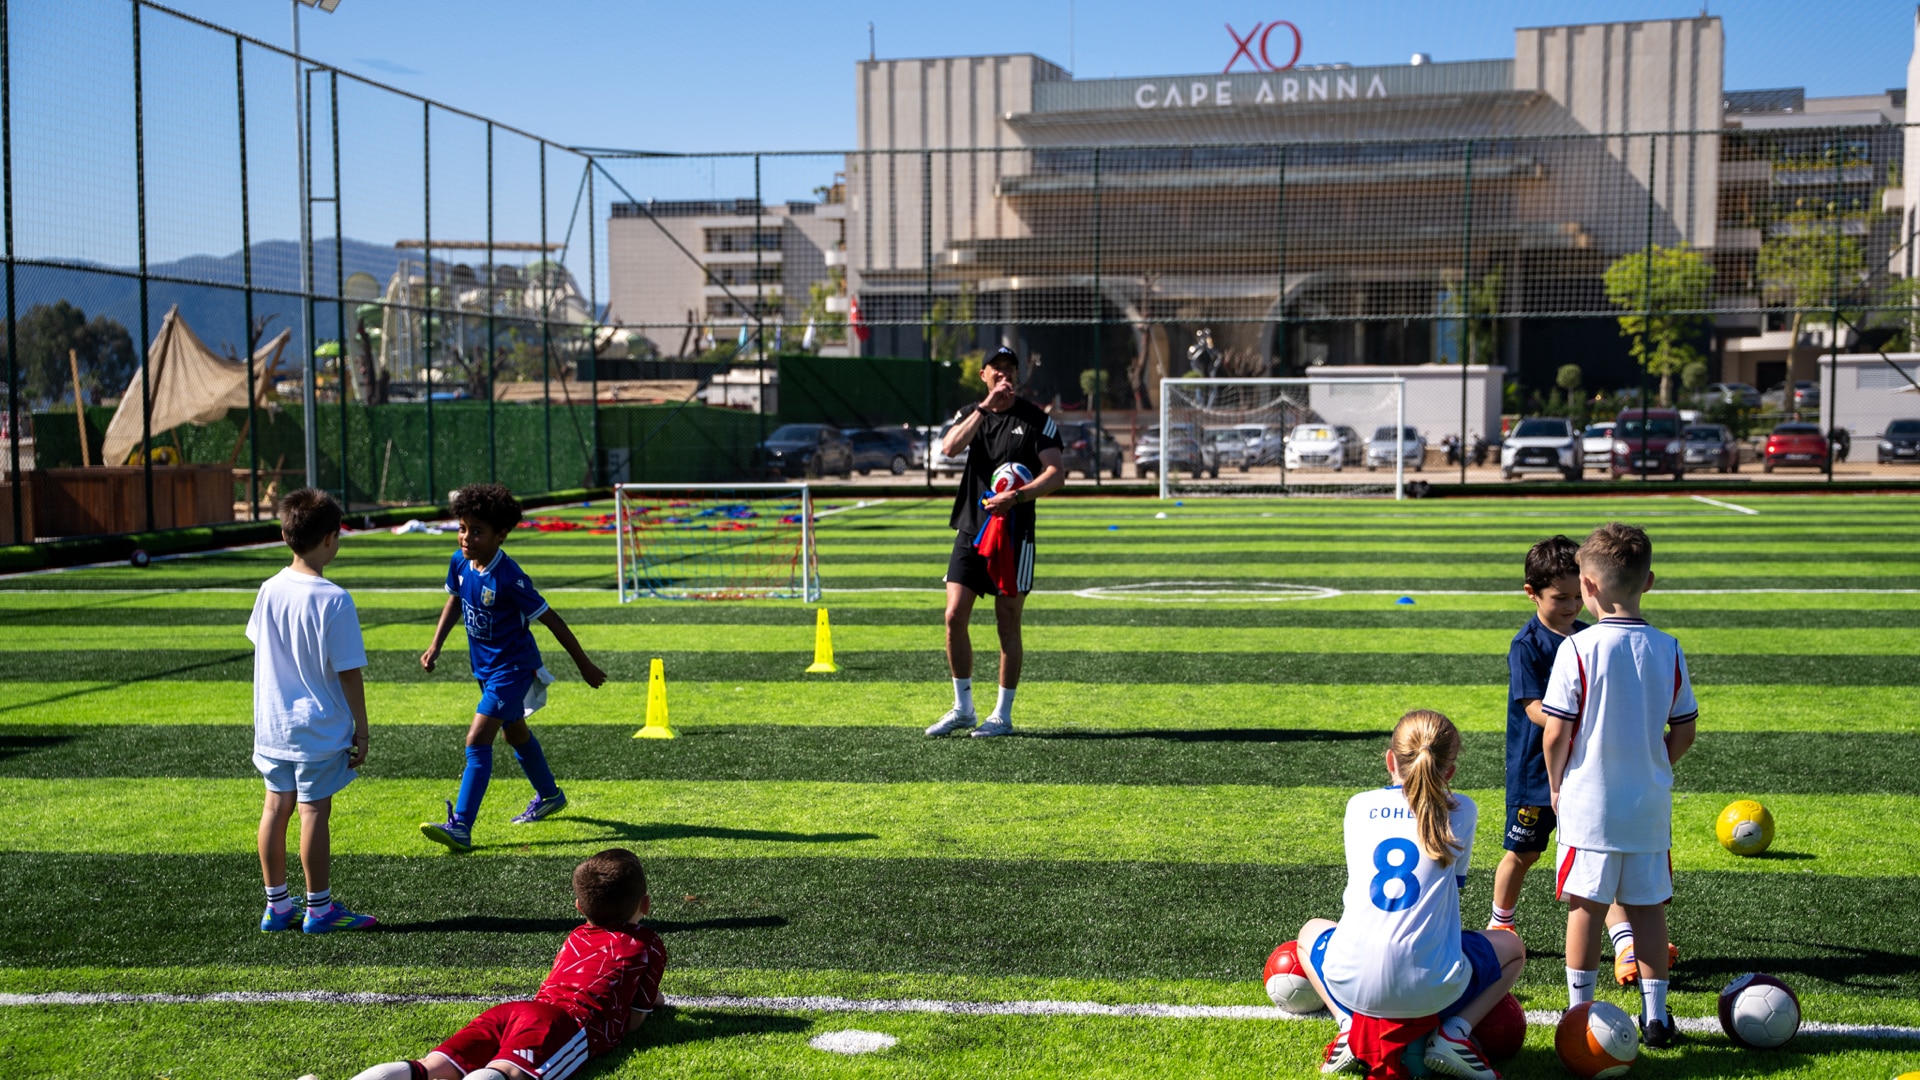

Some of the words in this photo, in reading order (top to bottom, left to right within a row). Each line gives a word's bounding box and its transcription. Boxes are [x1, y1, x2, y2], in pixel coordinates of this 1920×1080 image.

[1223, 20, 1303, 74] XO
[1135, 81, 1232, 109] CAPE
[1255, 74, 1387, 104] ARNNA
[1369, 837, 1421, 912] 8
